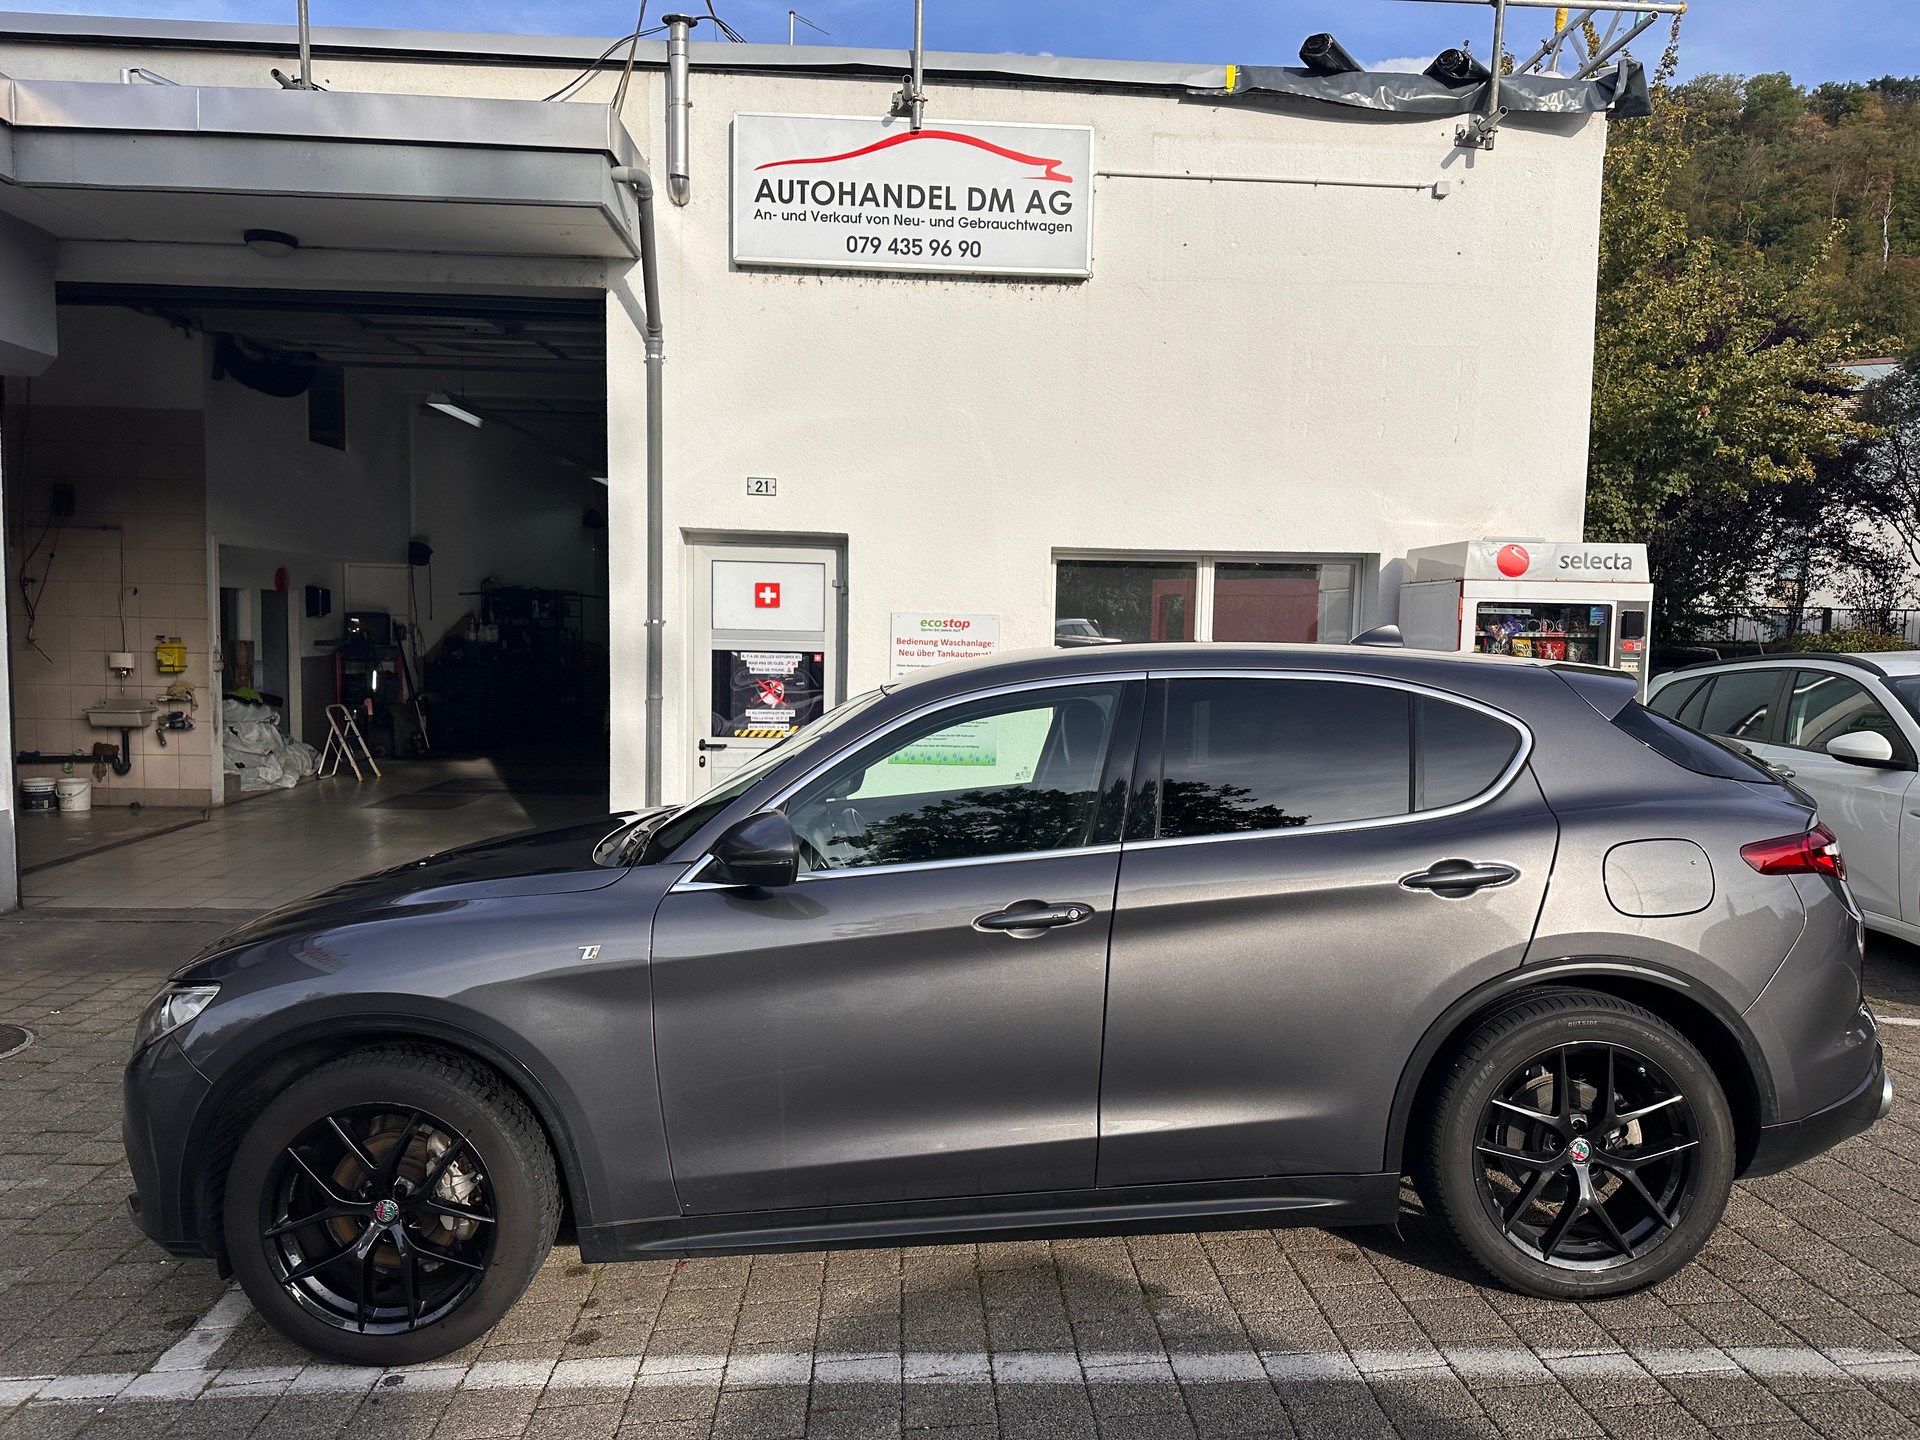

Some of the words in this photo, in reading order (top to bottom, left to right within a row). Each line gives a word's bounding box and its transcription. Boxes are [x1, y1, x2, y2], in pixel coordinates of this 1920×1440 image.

[754, 178, 957, 210] AUTOHANDEL
[968, 187, 1015, 213] DM
[1025, 190, 1073, 215] AG
[754, 208, 778, 220] An-
[782, 210, 806, 222] und
[811, 211, 862, 224] Verkauf
[866, 215, 890, 225] von
[894, 214, 925, 226] Neu-
[930, 216, 954, 228] und
[958, 216, 1073, 234] Gebrauchtwagen
[846, 236, 882, 254] 079
[888, 238, 923, 256] 435
[929, 239, 952, 257] 96
[958, 240, 982, 258] 90
[755, 480, 769, 493] 21
[1558, 552, 1632, 570] selecta
[920, 618, 970, 630] ecostop
[896, 638, 938, 647] Bedienung
[940, 639, 994, 648] Waschanlage:
[578, 944, 602, 960] Ti
